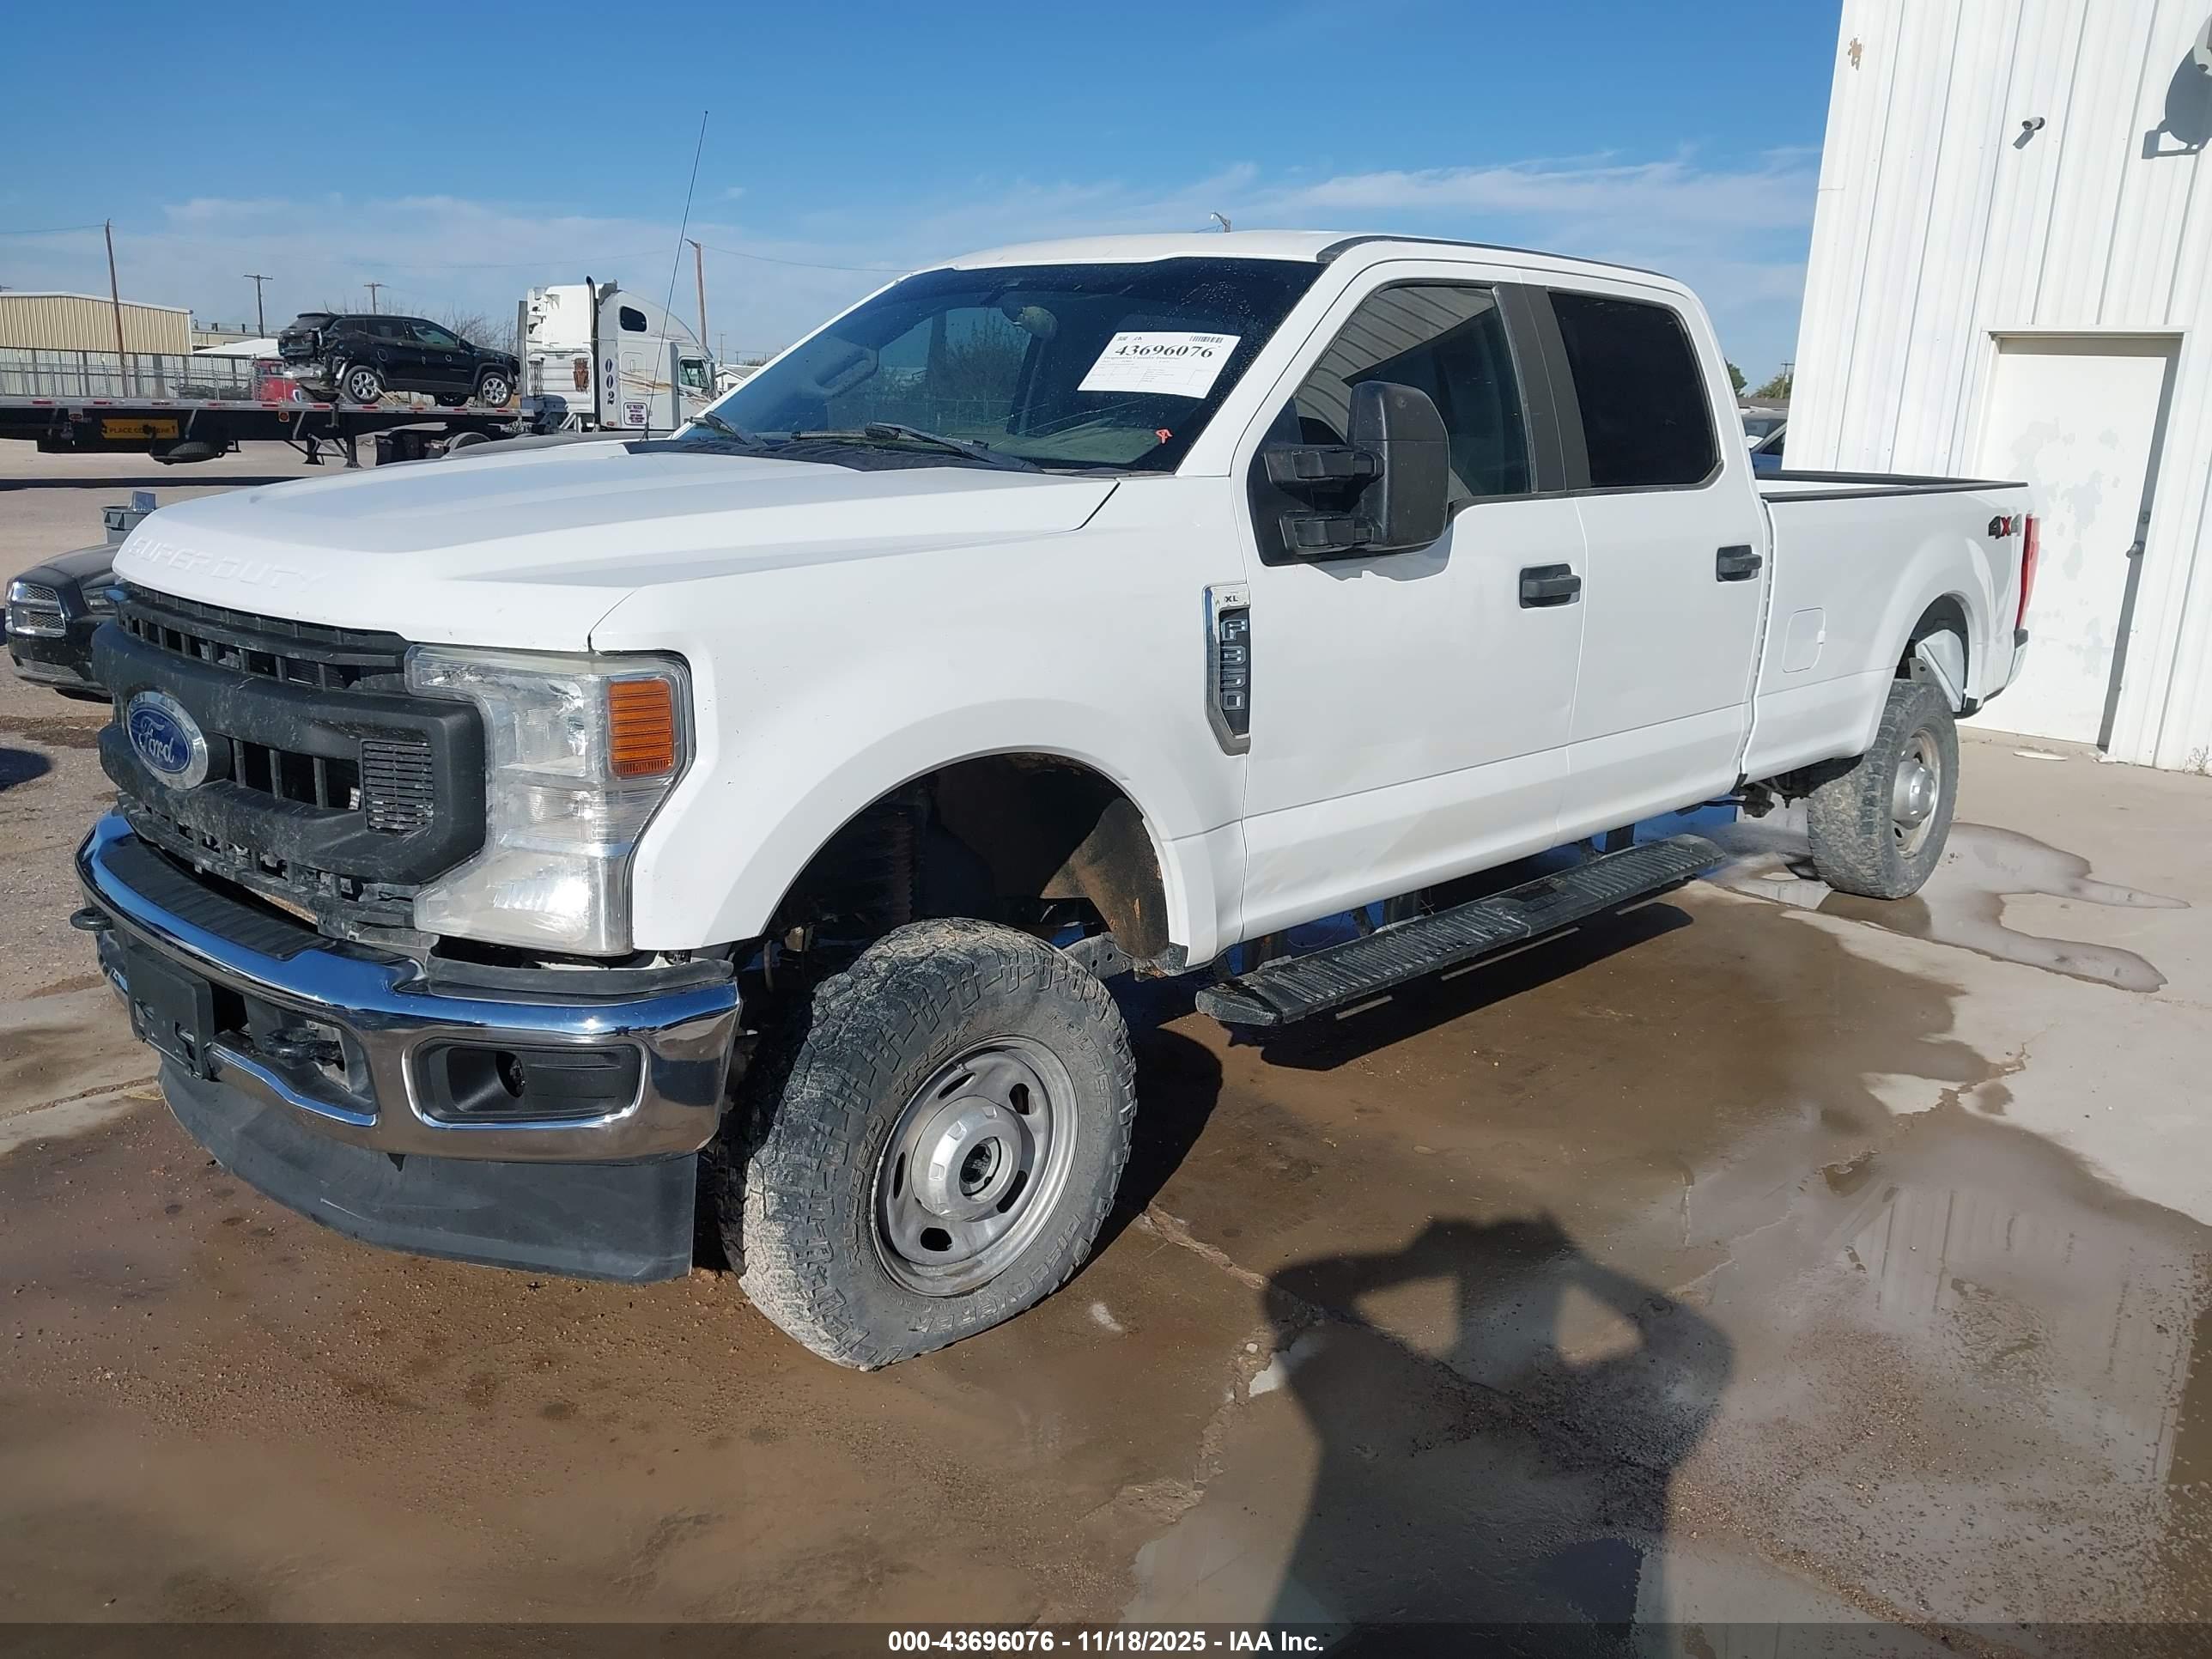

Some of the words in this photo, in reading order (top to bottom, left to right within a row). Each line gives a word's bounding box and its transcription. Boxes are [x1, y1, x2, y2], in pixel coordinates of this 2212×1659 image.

[1115, 344, 1217, 358] 43696076
[130, 536, 209, 571] SUPER
[211, 555, 330, 592] DUTY
[138, 715, 175, 763] Ford
[892, 1019, 974, 1096] TREK
